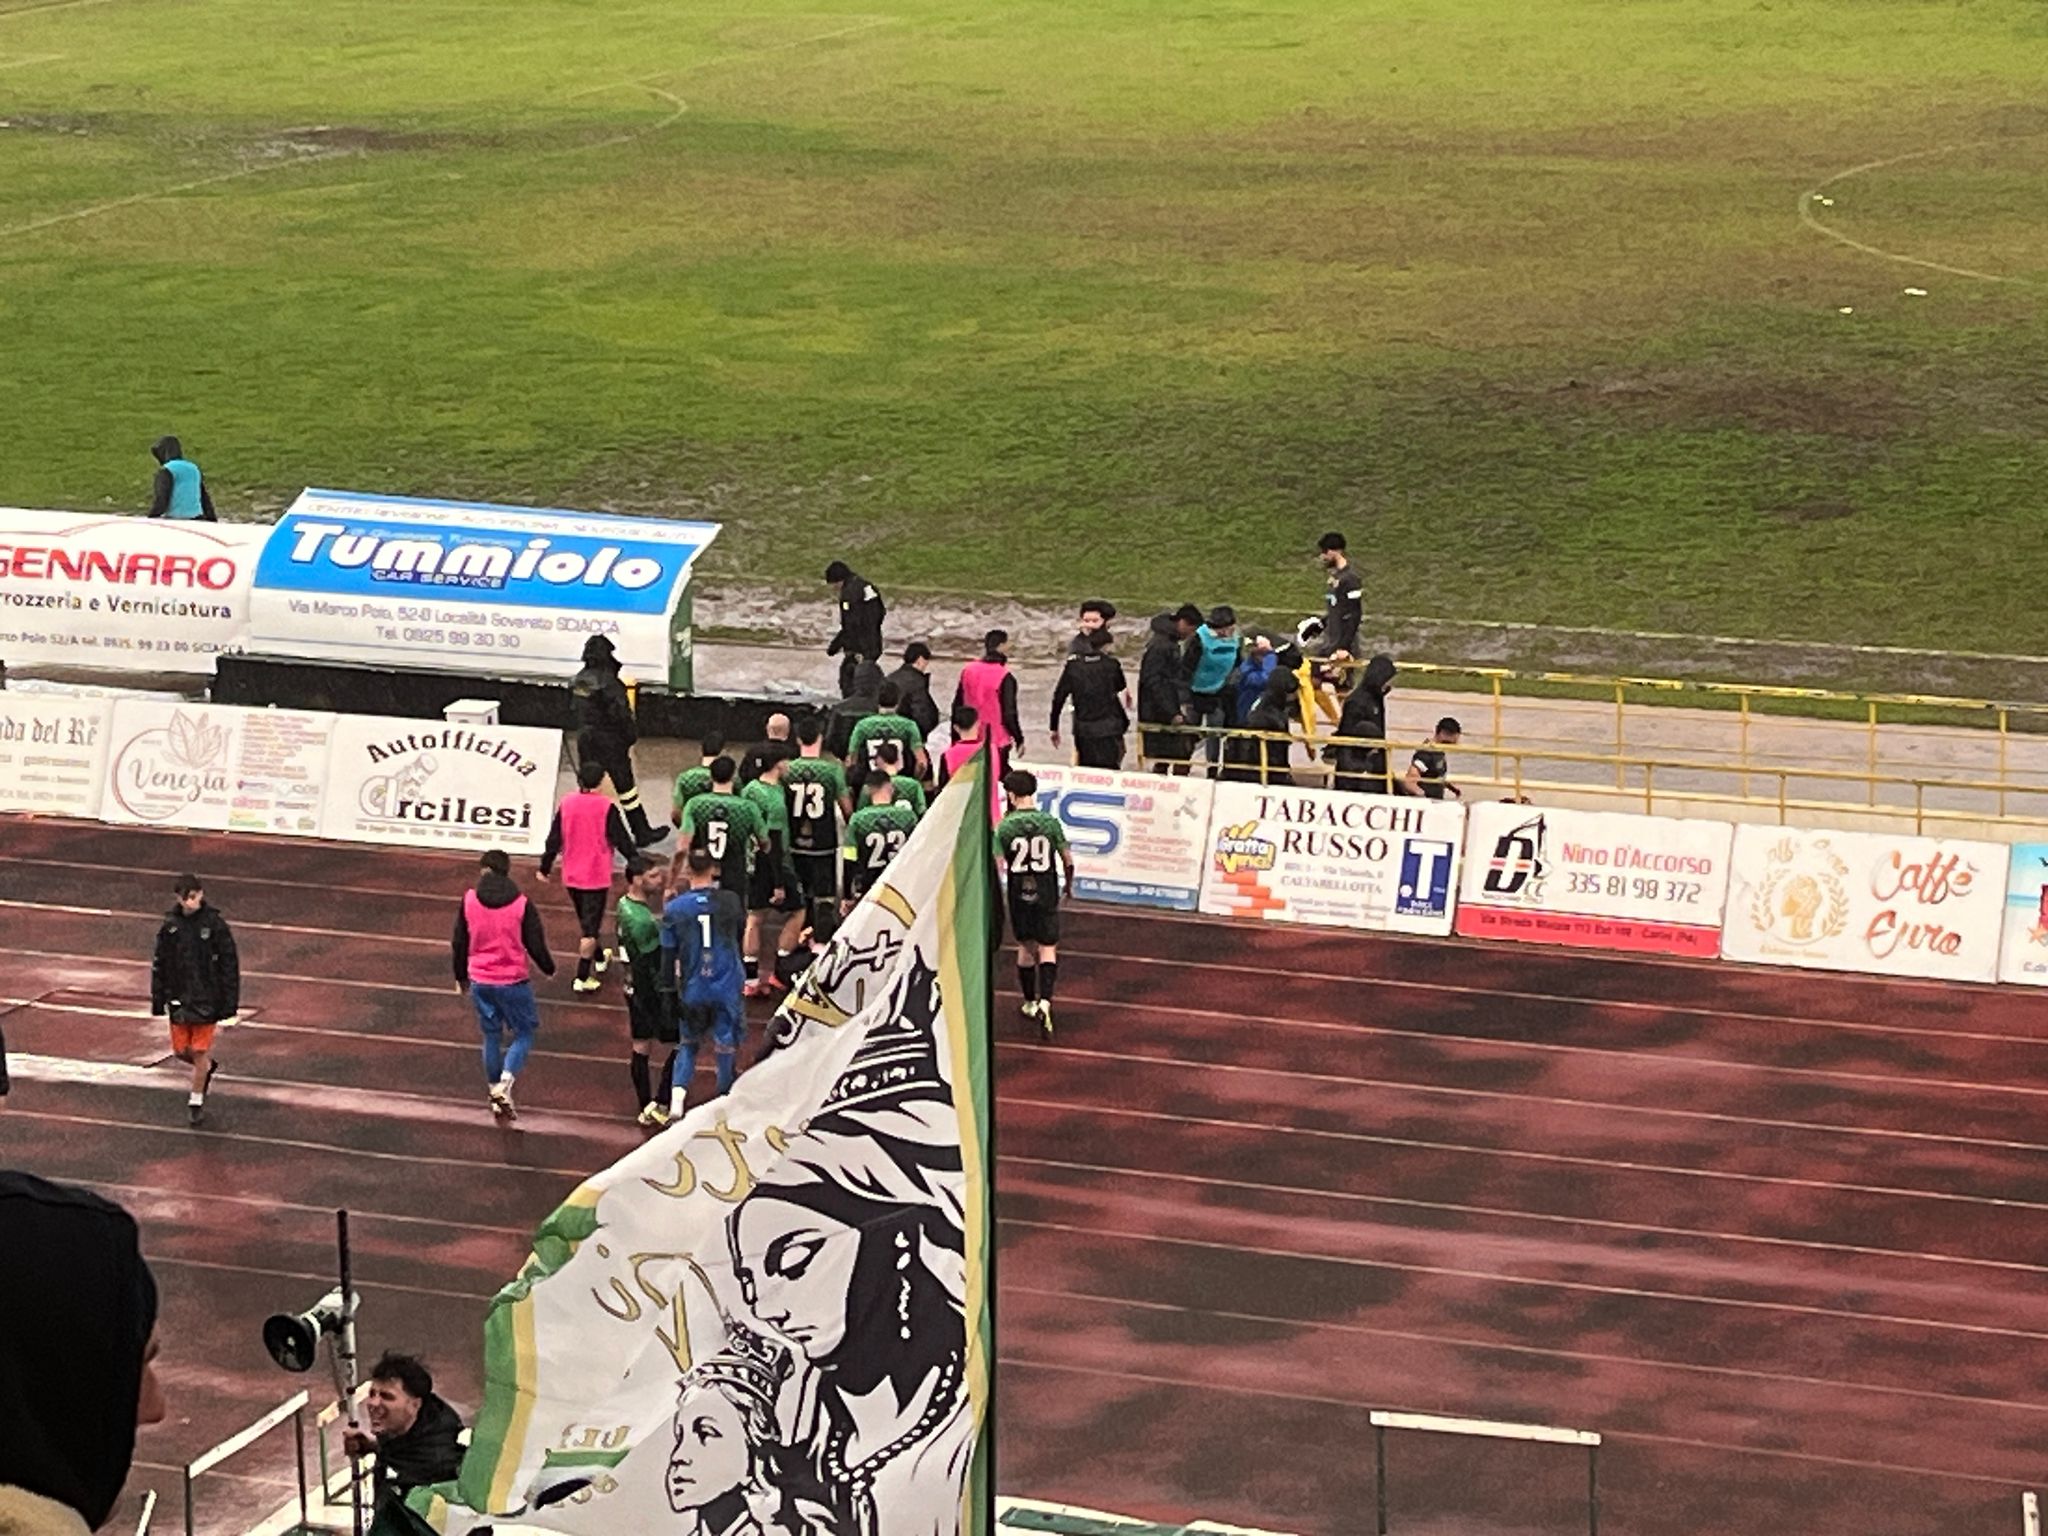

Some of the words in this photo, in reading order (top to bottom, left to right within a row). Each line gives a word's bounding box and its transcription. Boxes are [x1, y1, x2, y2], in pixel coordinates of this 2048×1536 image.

[290, 521, 665, 590] Tummiolo
[108, 596, 232, 619] Verniciatura
[288, 598, 310, 615] Via
[313, 601, 358, 618] Marco
[31, 717, 60, 744] del
[366, 729, 538, 779] Autofficina
[127, 756, 231, 803] Venezia
[789, 782, 826, 819] 73
[1255, 795, 1426, 834] TABACCHI
[706, 821, 730, 860] 5
[1010, 835, 1053, 873] 29
[1282, 828, 1390, 863] RUSSO
[1562, 842, 1609, 867] Nino
[1614, 844, 1713, 876] D'Accorso
[1566, 871, 1602, 894] 335
[1607, 875, 1627, 897] 81
[1632, 878, 1660, 900] 98
[1664, 881, 1703, 905] 372
[1871, 850, 1980, 905] Caffè
[696, 914, 713, 949] 1
[1863, 909, 1965, 960] Euro
